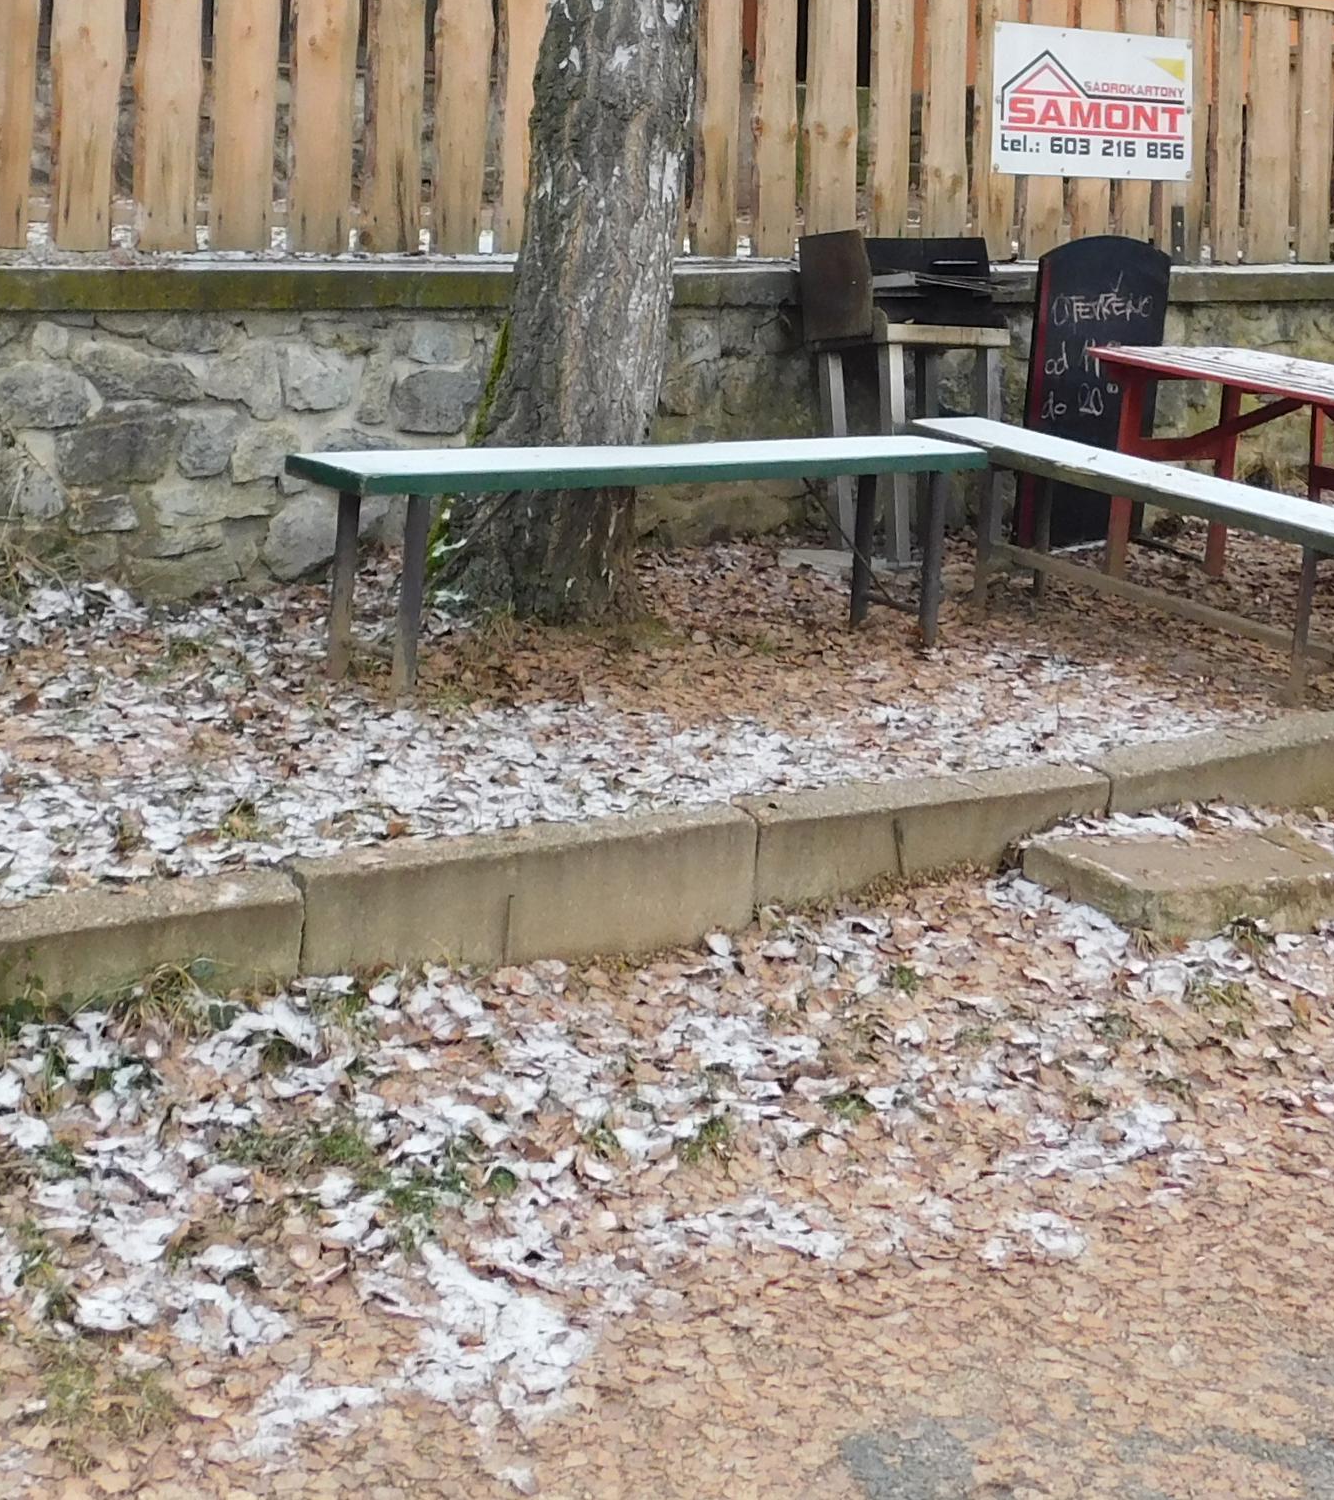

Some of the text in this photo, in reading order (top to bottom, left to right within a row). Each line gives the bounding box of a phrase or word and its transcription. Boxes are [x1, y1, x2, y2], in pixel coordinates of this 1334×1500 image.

[1008, 97, 1185, 133] SAMONT
[1000, 133, 1185, 160] tel.: 603 216 856
[1044, 340, 1069, 375] od
[1041, 390, 1067, 420] do
